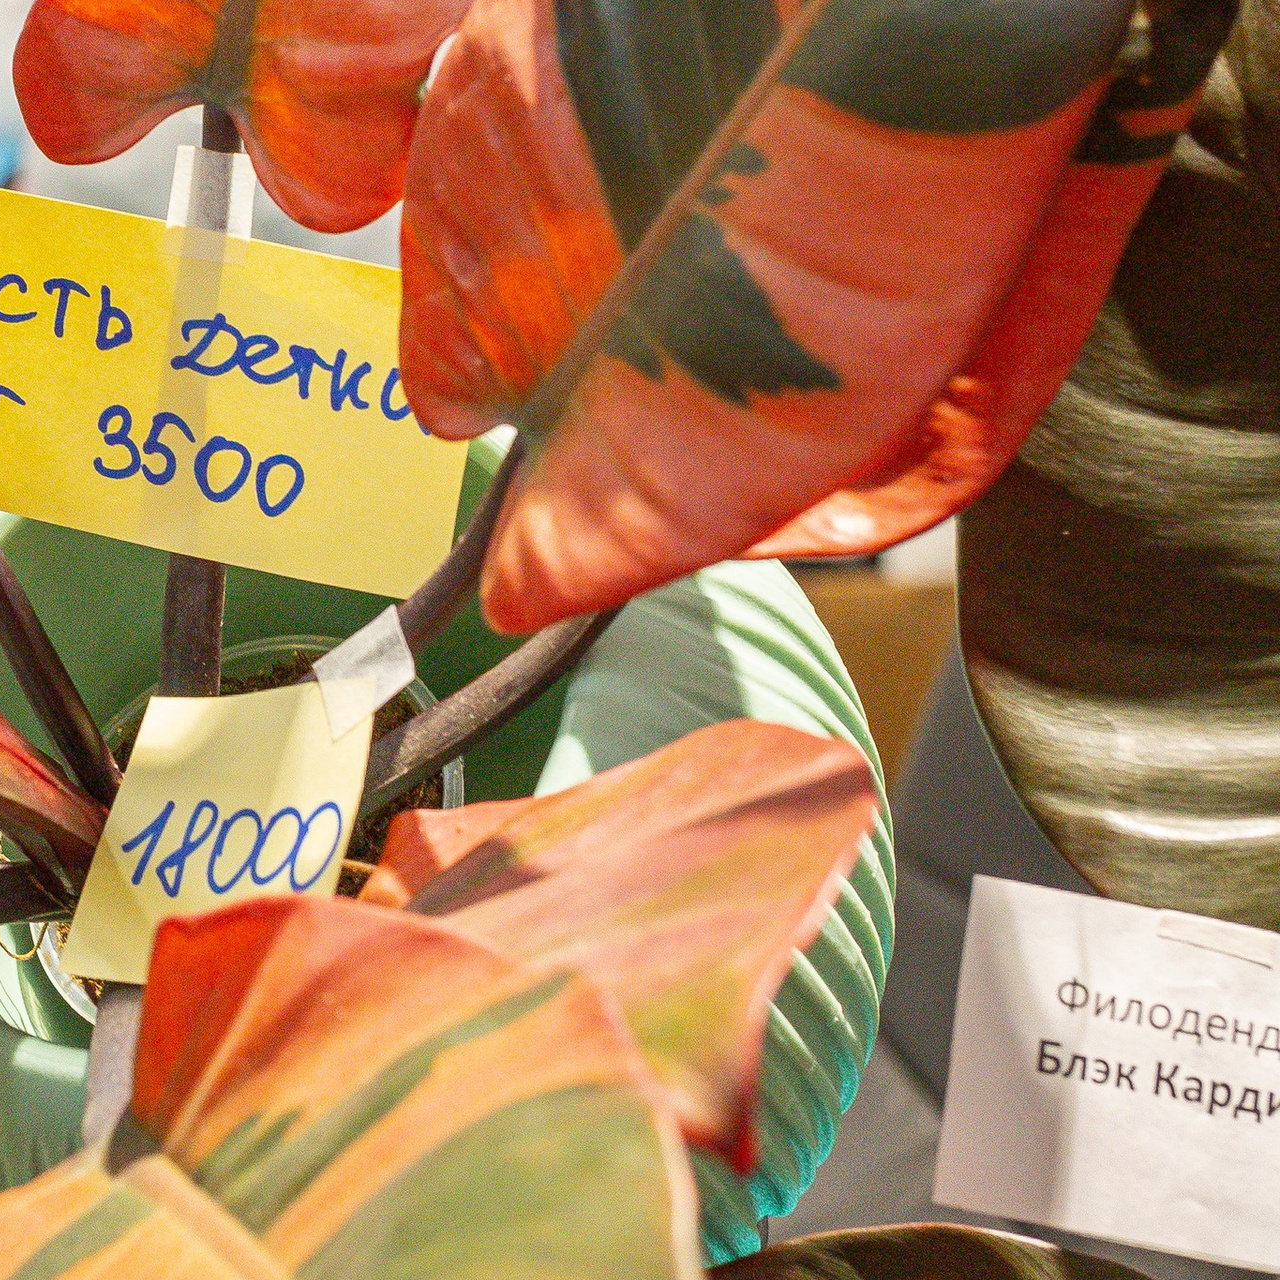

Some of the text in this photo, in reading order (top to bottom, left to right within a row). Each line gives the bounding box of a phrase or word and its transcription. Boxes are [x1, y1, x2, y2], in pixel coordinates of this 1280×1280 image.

[93, 404, 305, 518] 3500
[121, 799, 344, 898] 18000
[1035, 1037, 1138, 1093] Блэк
